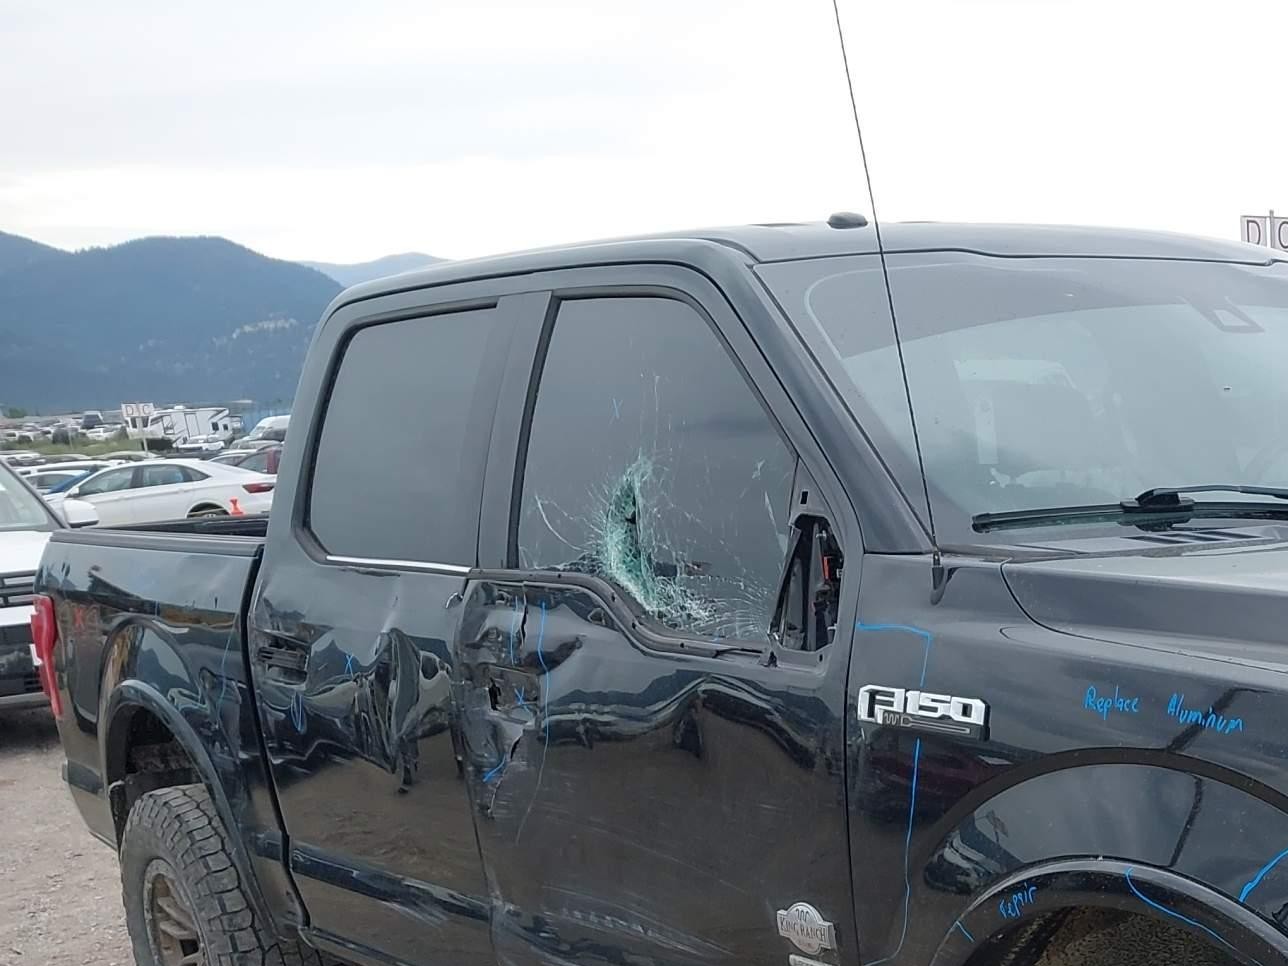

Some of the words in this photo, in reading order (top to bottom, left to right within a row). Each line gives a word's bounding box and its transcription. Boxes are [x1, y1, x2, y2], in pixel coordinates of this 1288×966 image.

[1246, 219, 1261, 245] D
[1084, 684, 1140, 721] Replace
[1166, 692, 1244, 735] Aluminum
[780, 918, 799, 936] KING
[799, 926, 827, 943] RANCH
